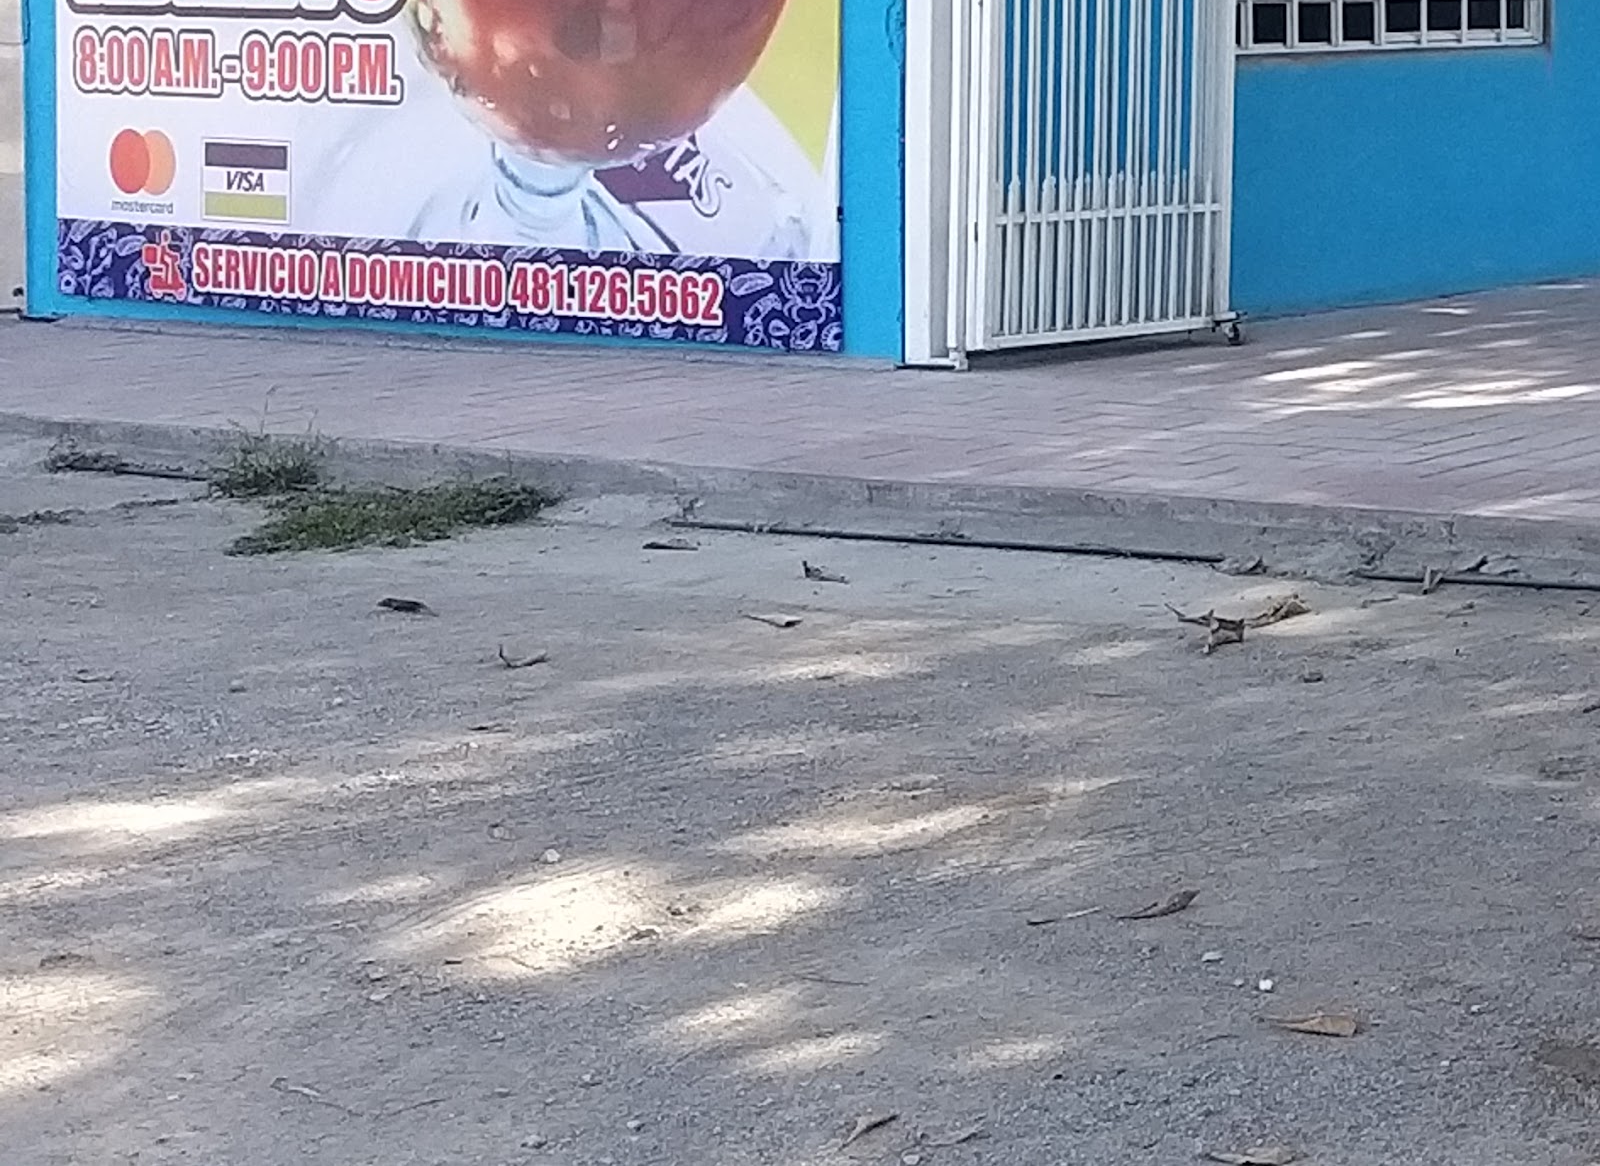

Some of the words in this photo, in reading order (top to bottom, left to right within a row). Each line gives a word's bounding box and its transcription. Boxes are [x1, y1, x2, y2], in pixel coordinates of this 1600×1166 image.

[79, 34, 146, 87] 8:00
[153, 37, 218, 90] A.M.
[245, 39, 324, 94] 9:00
[332, 42, 398, 96] P.M.
[226, 170, 265, 192] VISA
[111, 200, 174, 214] mastercard
[194, 248, 318, 297] SERVICIO
[321, 254, 344, 298] A
[349, 257, 503, 309] DOMICILIO
[510, 265, 721, 323] 481.126.5662
